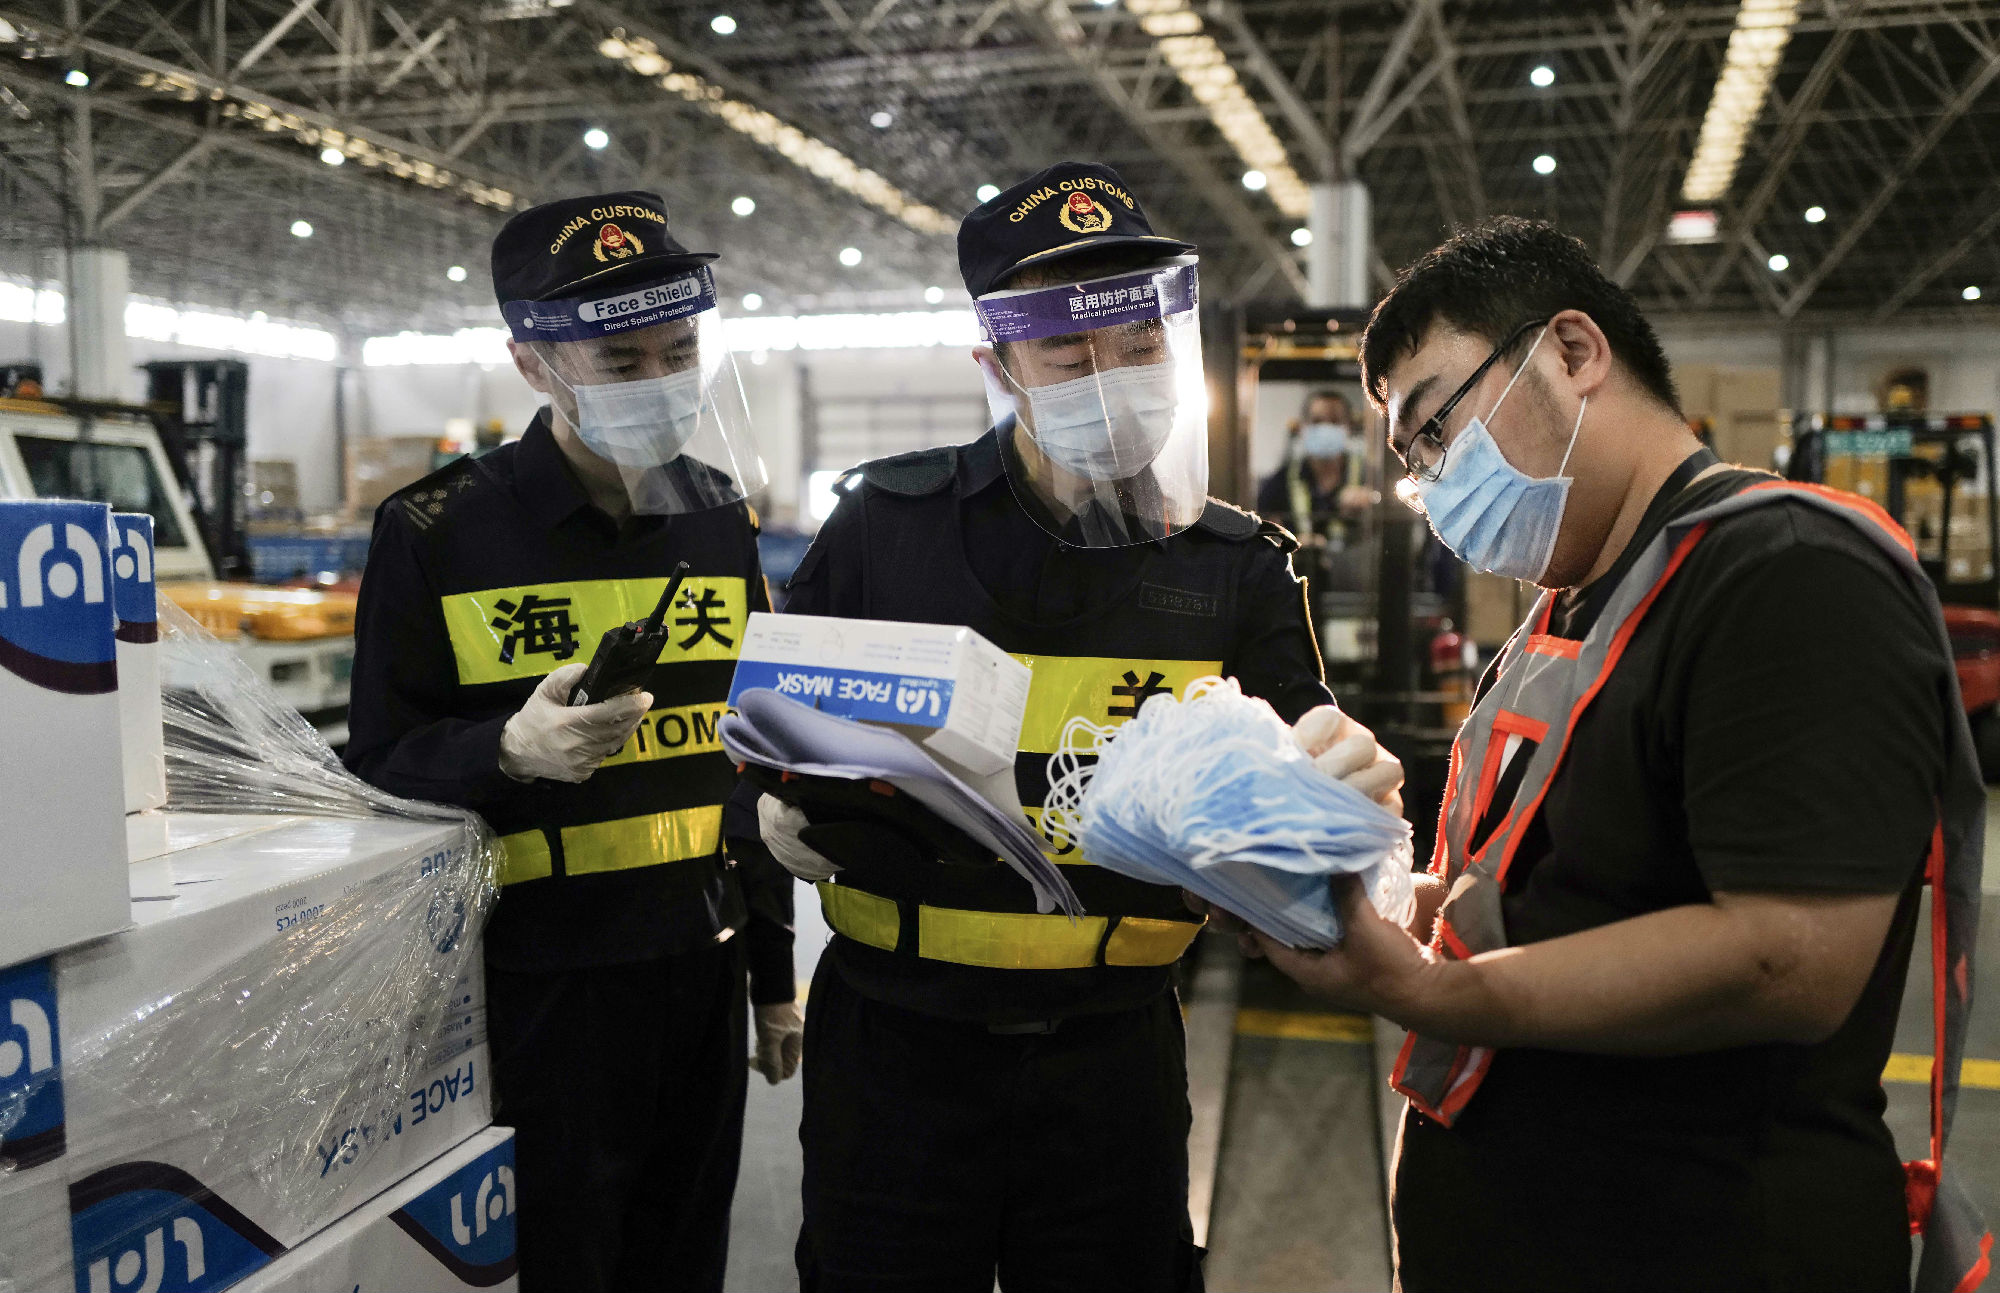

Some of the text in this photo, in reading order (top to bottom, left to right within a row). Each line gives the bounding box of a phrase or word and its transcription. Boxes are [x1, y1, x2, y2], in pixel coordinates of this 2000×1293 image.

[1009, 177, 1135, 223] CHINA CUSTOMS
[550, 205, 665, 256] CHINA CUSTOMS
[593, 281, 693, 318] Face Shield
[1068, 284, 1157, 312] 医用防护面罩
[1071, 301, 1156, 321] Medical protective mask
[603, 304, 694, 331] Direct Splash Protection
[774, 671, 834, 697] MASK
[837, 678, 892, 703] FACE
[276, 914, 297, 932] PCS
[410, 1061, 474, 1126] FACE
[319, 1109, 402, 1179] MSK
